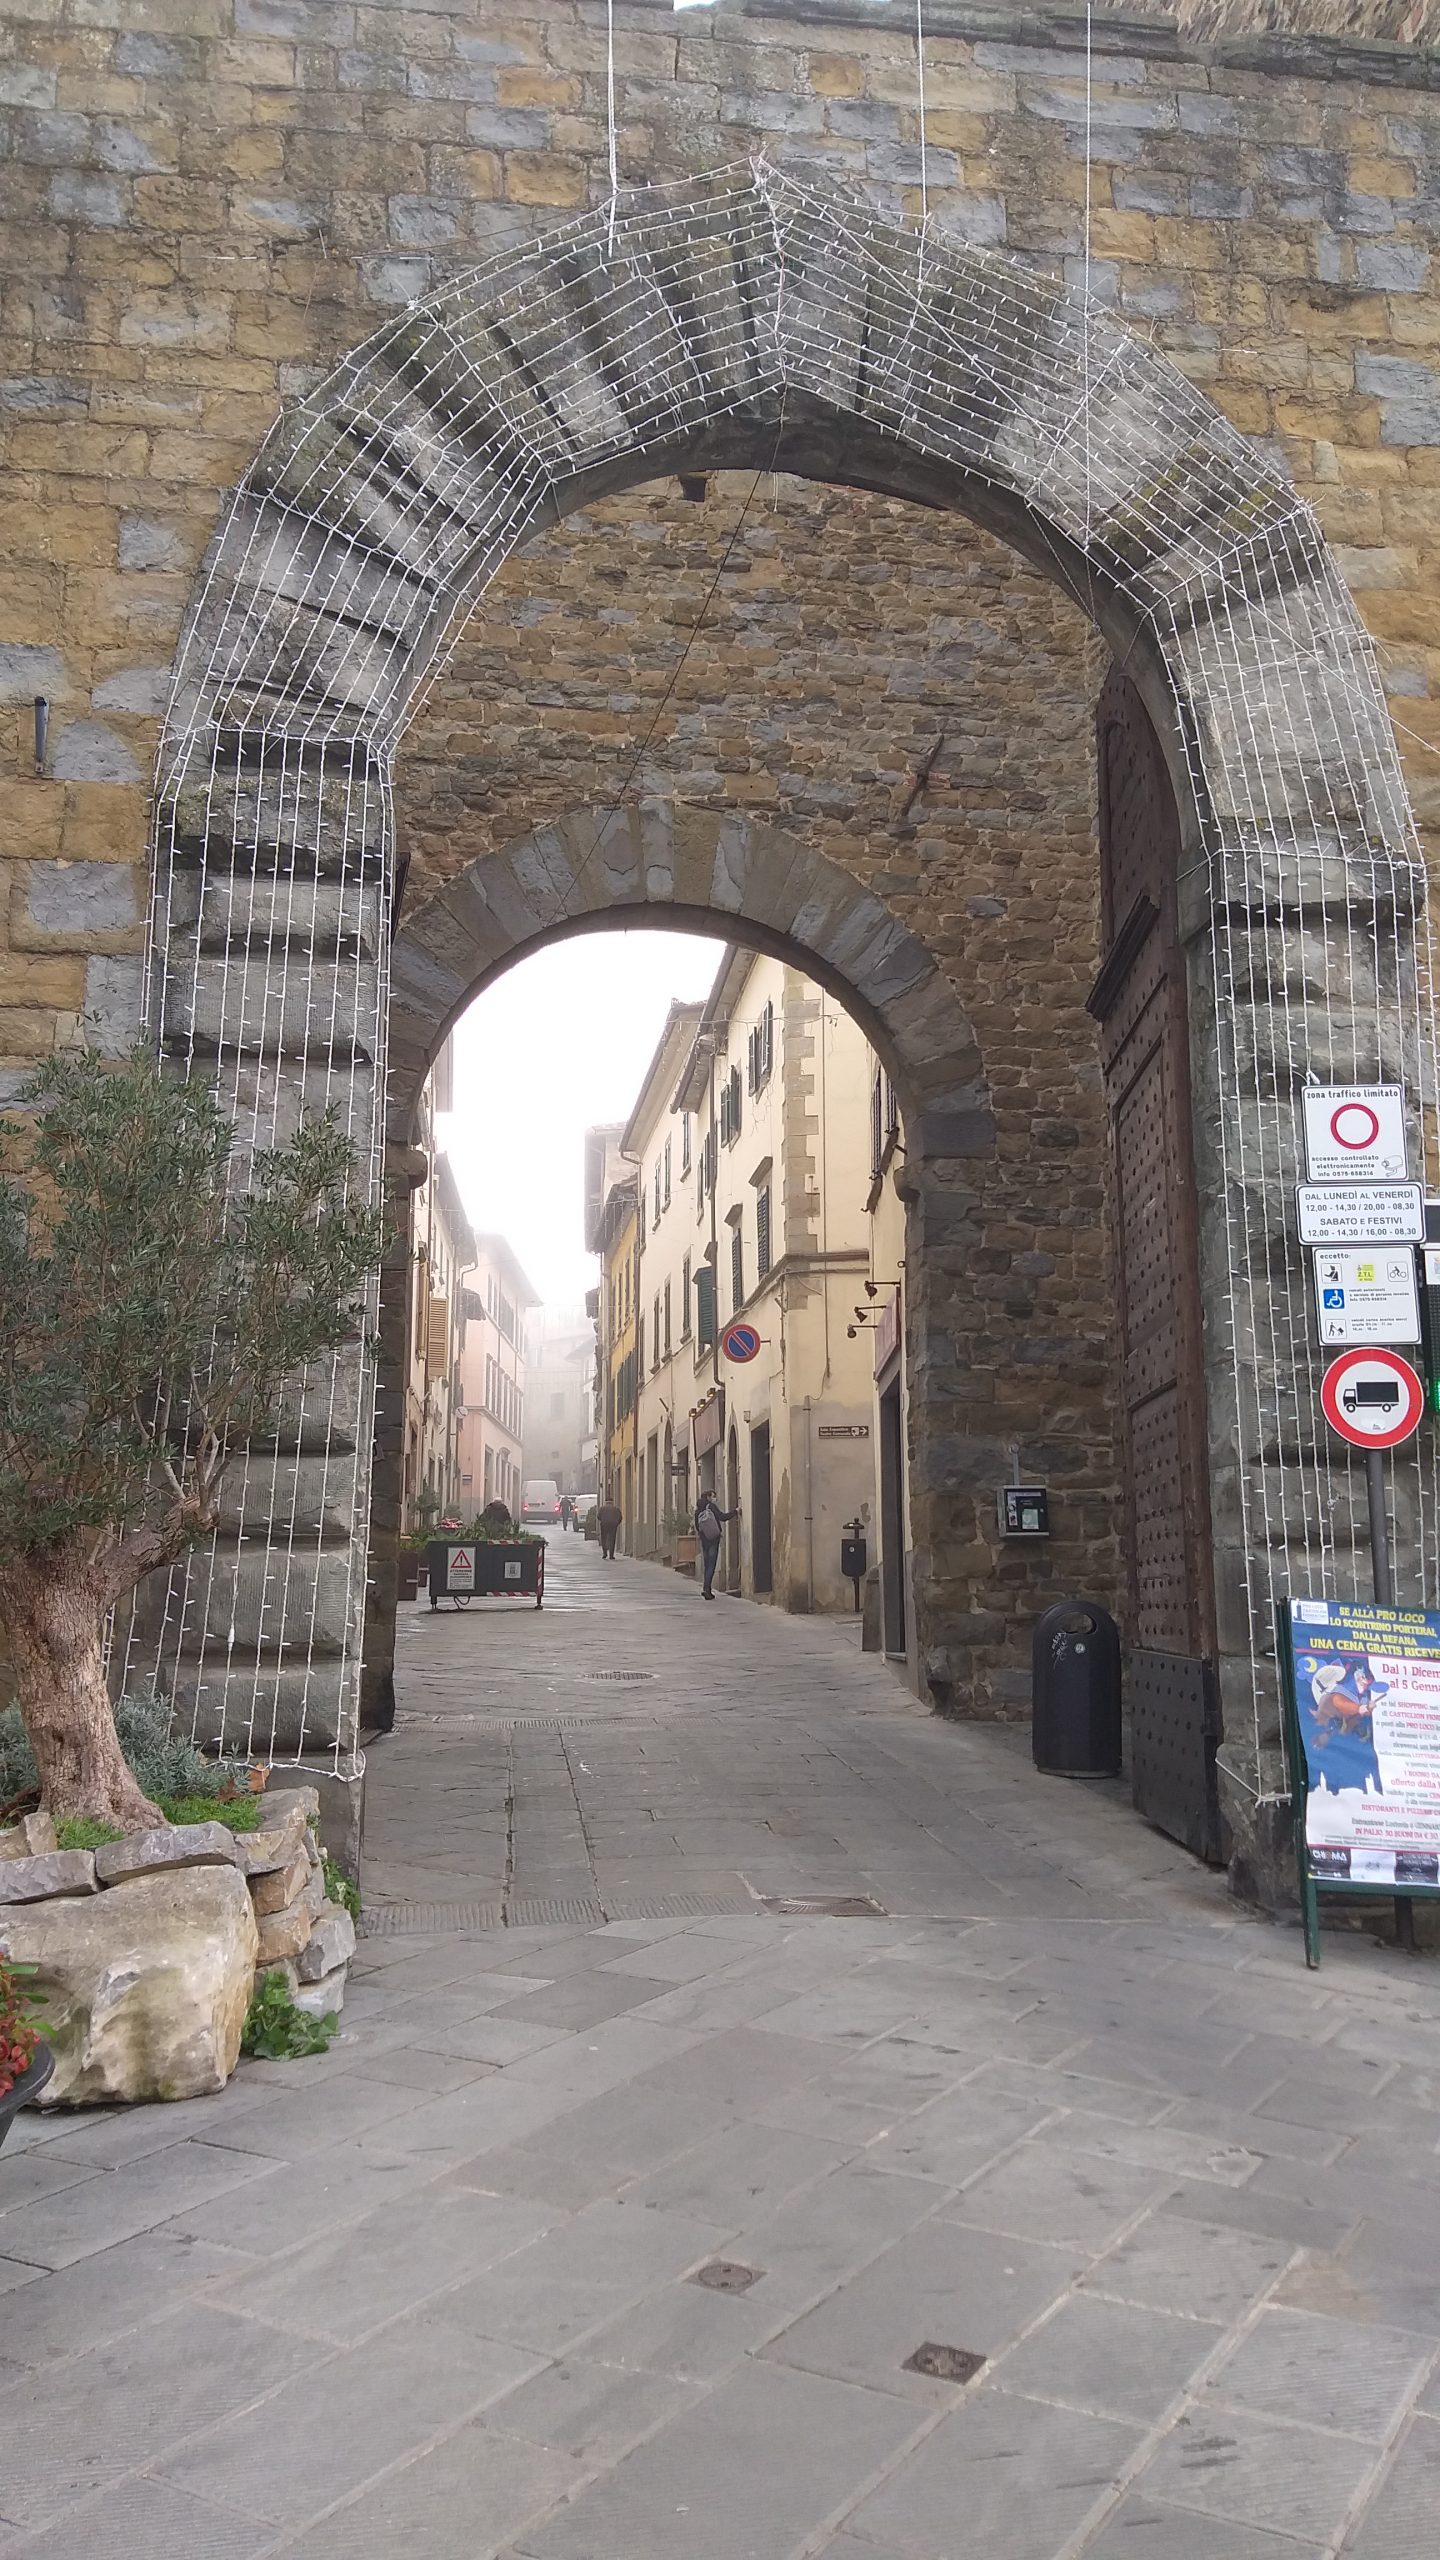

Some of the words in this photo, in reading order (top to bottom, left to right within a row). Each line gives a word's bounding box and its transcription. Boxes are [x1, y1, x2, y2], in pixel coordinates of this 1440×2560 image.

[1328, 1090, 1362, 1098] traffico
[1364, 1088, 1398, 1098] limitato
[1324, 1190, 1357, 1200] LUNEDÌ
[1372, 1189, 1413, 1199] VENERDÌ
[1368, 1217, 1402, 1225] FESTIVI
[1339, 1606, 1349, 1616] SE
[1352, 1608, 1374, 1619] ALLA
[1376, 1610, 1396, 1621] PRO
[1398, 1612, 1425, 1624] LOCO
[1329, 1617, 1342, 1626] LO
[1343, 1618, 1391, 1632] SCONTRINO
[1352, 1631, 1381, 1642] DALLA
[1382, 1634, 1418, 1646] BEFANA
[1310, 1638, 1334, 1649] UNA
[1336, 1640, 1365, 1652] CENA
[1366, 1643, 1402, 1655] GRATIS
[1382, 1664, 1399, 1674] Dal
[1403, 1666, 1407, 1675] 1
[1390, 1679, 1399, 1688] al
[1402, 1680, 1408, 1689] 5
[1398, 1702, 1428, 1710] SHOPPING
[1362, 1804, 1399, 1813] RISTORANTI
